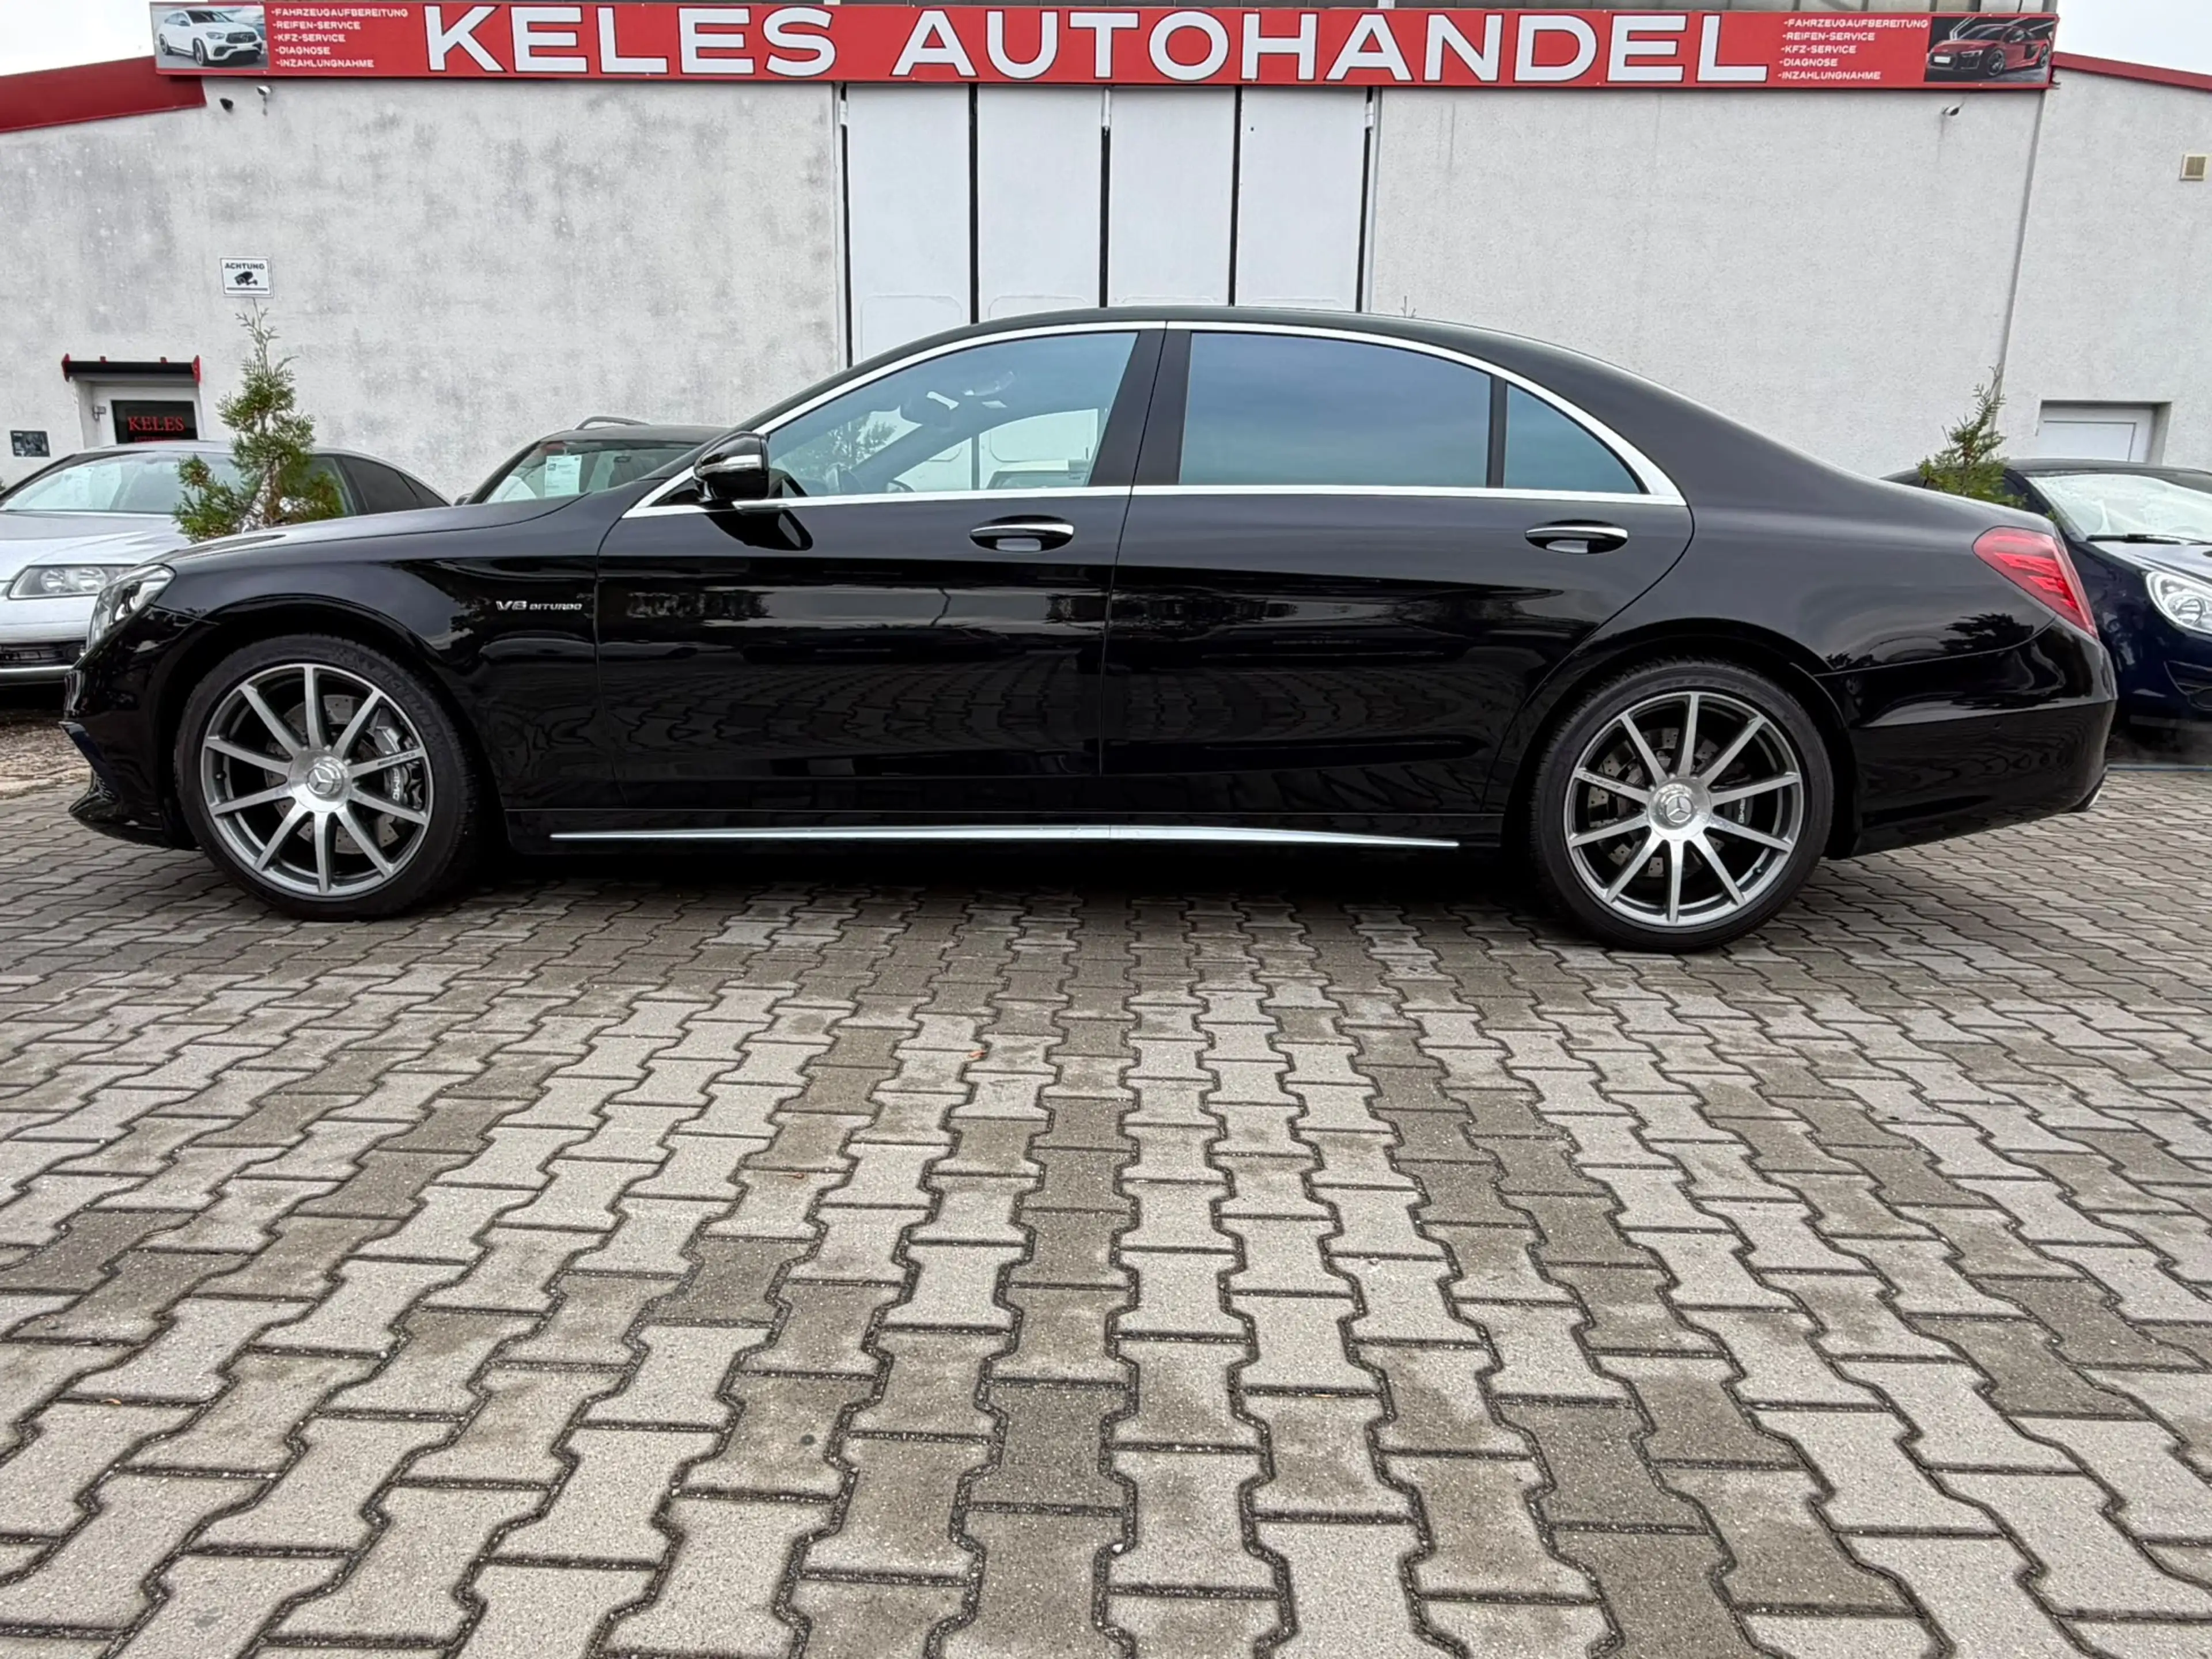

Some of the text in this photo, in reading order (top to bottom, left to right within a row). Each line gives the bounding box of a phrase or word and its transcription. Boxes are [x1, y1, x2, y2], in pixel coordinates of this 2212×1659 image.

[271, 8, 408, 18] -FAHRZEUGAUFBEREITUNG
[272, 21, 361, 30] -REIFEN-SERVICE
[1783, 18, 1929, 28] -FAHRZEUGAUFBEREITUNG
[274, 33, 346, 42] -KFZ-SERVICE
[1782, 32, 1876, 40] -REIFEN-SERVICE
[424, 5, 1768, 82] KELES AUTOHANDEL
[275, 46, 331, 55] -DIAGNOSE
[1781, 45, 1857, 54] -KFZ-SERVICE
[1779, 58, 1838, 66] -DIAGNOSE
[127, 416, 184, 431] KELES
[495, 601, 527, 611] V8
